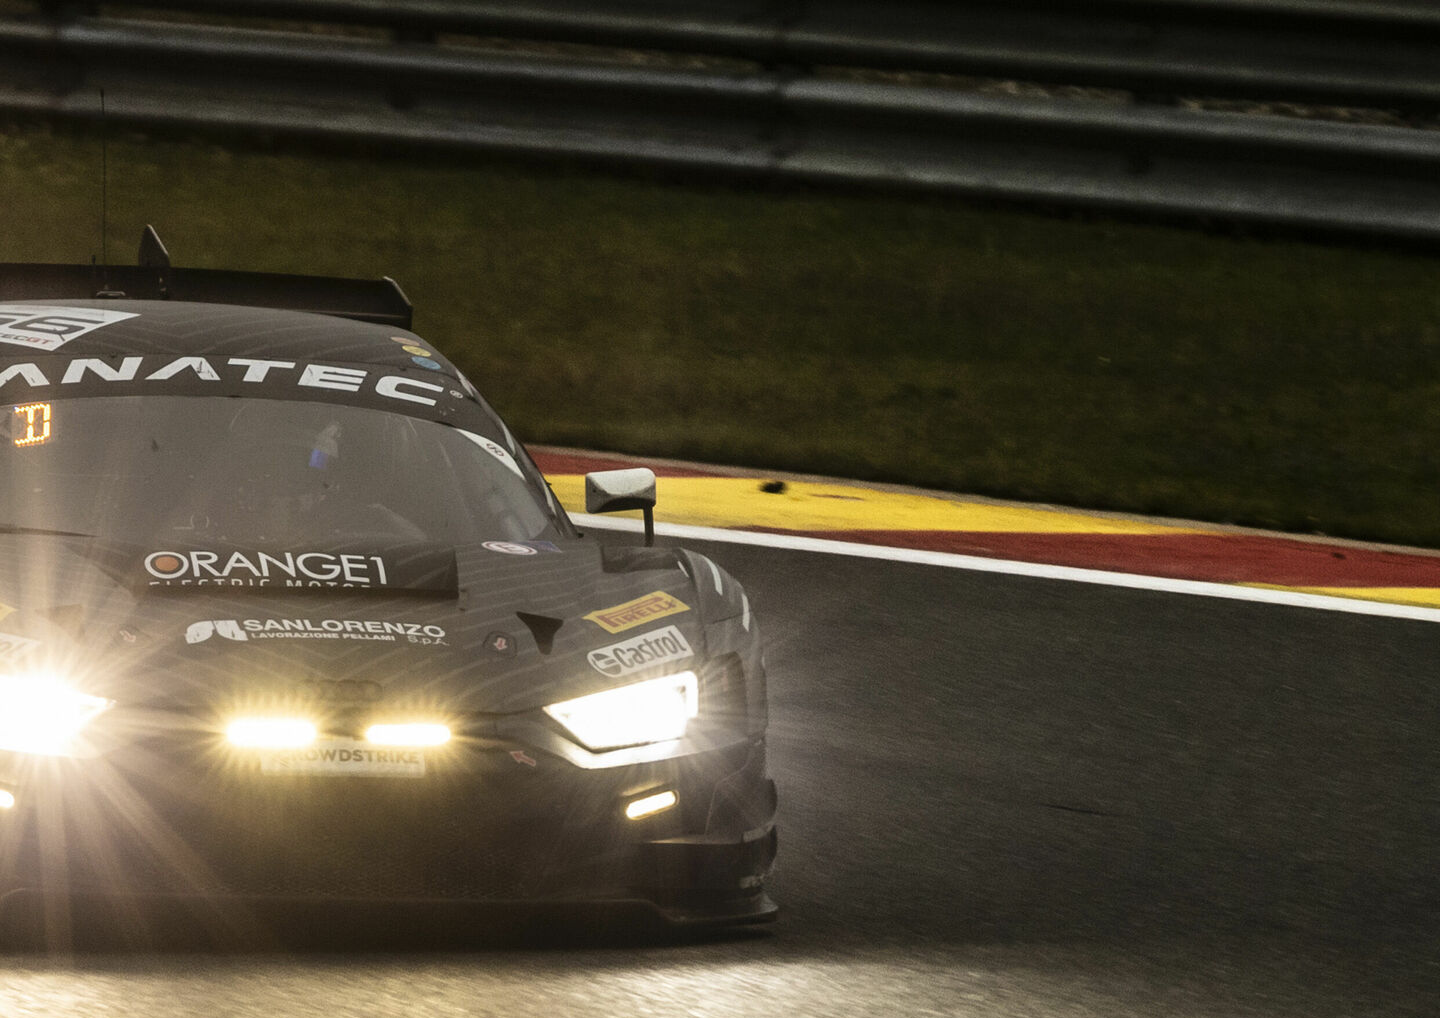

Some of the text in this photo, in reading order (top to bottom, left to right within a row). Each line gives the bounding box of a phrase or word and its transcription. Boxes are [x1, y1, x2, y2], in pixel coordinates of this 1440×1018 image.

[143, 550, 389, 586] ORANGE1
[596, 595, 678, 628] PIRELLI
[242, 618, 447, 639] SANLORENZO
[251, 631, 341, 641] LAVORAZIONE
[343, 633, 396, 643] PELLAMI
[611, 630, 688, 669] Castrol
